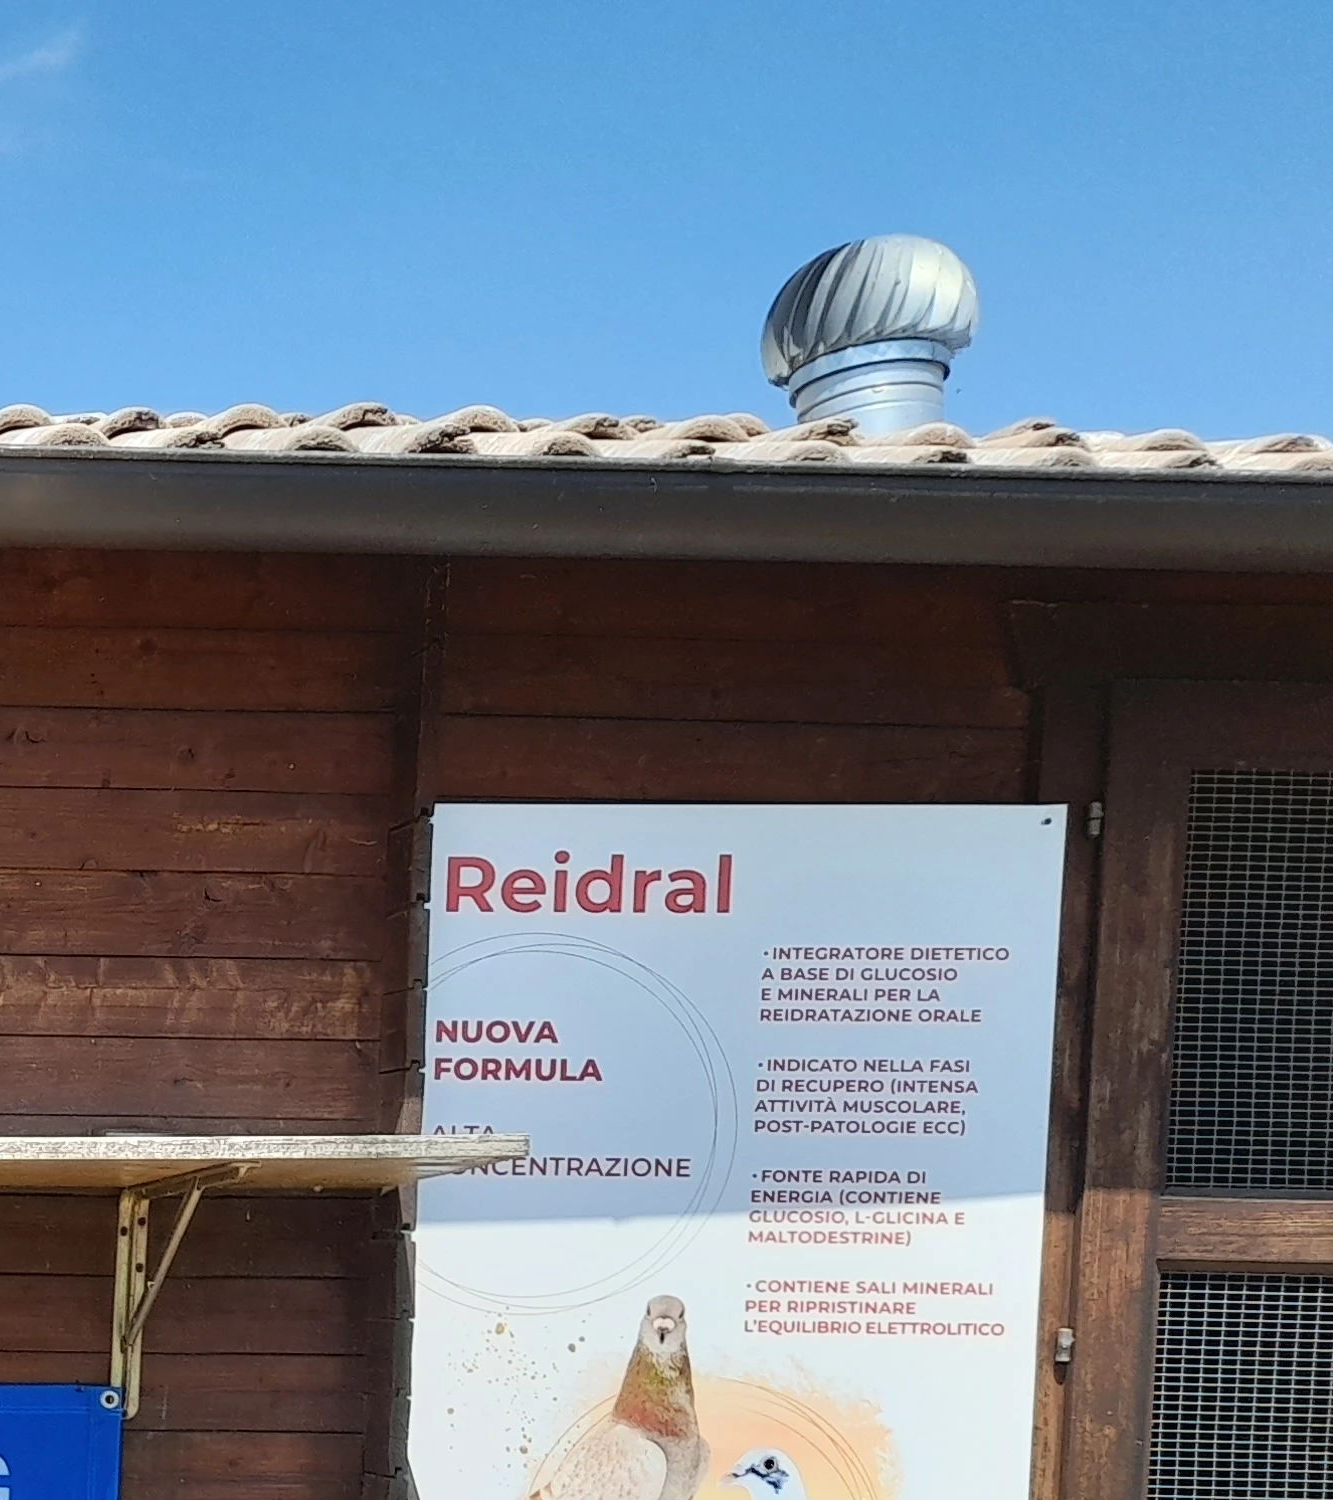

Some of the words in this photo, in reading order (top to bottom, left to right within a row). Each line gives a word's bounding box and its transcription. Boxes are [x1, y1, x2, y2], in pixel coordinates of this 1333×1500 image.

[445, 850, 732, 913] Reidral
[772, 947, 904, 961] INTEGRATORE
[910, 948, 1010, 961] DIETETICO
[761, 968, 774, 981] A
[781, 968, 829, 981] BASE
[836, 968, 854, 981] DI
[861, 968, 958, 981] GLUCOSIO
[761, 988, 772, 1000] E
[778, 988, 868, 1001] MINERALI
[874, 989, 911, 1002] PER
[917, 989, 940, 1002] LA
[760, 1008, 912, 1022] REIDRATAZIONE
[918, 1009, 982, 1022] ORALE
[435, 1020, 558, 1043] NUOVA
[434, 1058, 602, 1081] FORMULA
[768, 1059, 857, 1072] INDICATO
[863, 1060, 923, 1072] NELLA
[930, 1060, 970, 1072] FASI
[757, 1079, 775, 1092] DI
[782, 1080, 884, 1093] RECUPERO
[891, 1080, 978, 1095] (INTENSA
[755, 1097, 836, 1113] ATTIVITÀ
[843, 1100, 966, 1115] MUSCOLARE,
[754, 1120, 916, 1134] POST-PATOLOGIE
[923, 1120, 966, 1136] ECC)
[451, 1157, 692, 1178] NCENTRAZIONE
[762, 1170, 823, 1183] FONTE
[829, 1170, 901, 1183] RAPIDA
[907, 1171, 926, 1184] DI
[751, 1190, 833, 1203] ENERGIA
[840, 1190, 941, 1205] (CONTIENE
[749, 1210, 849, 1226] GLUCOSIO,
[855, 1211, 949, 1225] L-GLICINA
[955, 1212, 965, 1225] E
[748, 1230, 911, 1246] MALTODESTRINE)
[755, 1280, 850, 1293] CONTIENE
[856, 1281, 896, 1293] SALI
[903, 1282, 993, 1295] MINERALI
[745, 1300, 781, 1312] PER
[787, 1301, 916, 1314] RIPRISTINARE
[744, 1320, 862, 1335] L'EQUILIBRIO
[866, 1322, 1005, 1336] ELETTROLITICO
